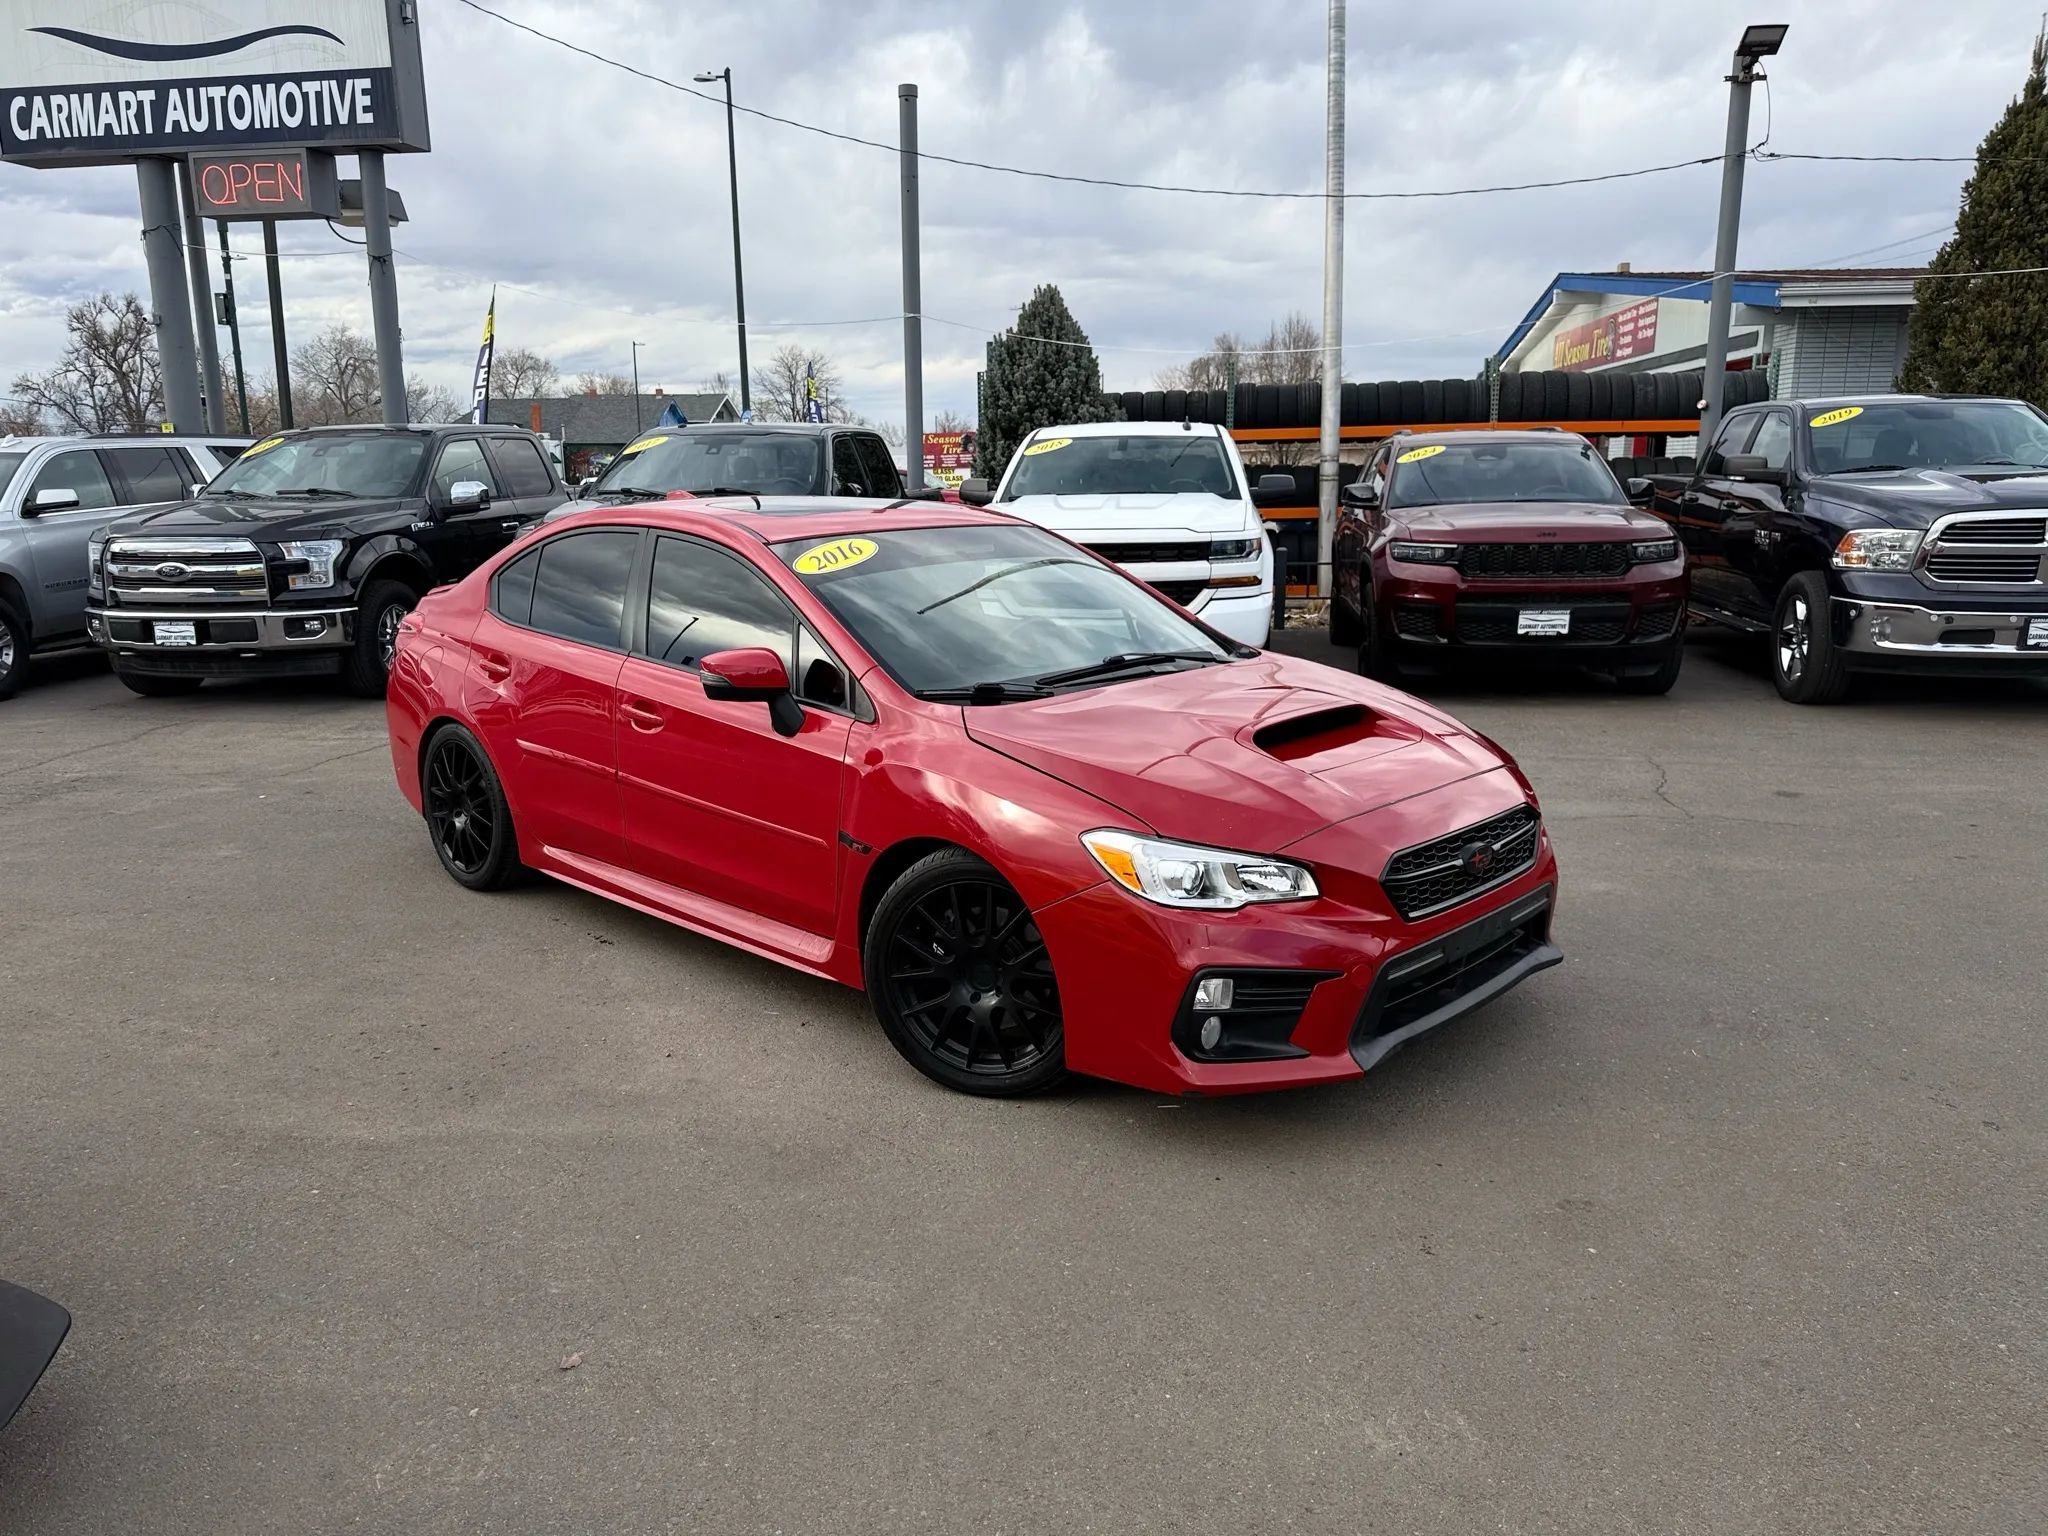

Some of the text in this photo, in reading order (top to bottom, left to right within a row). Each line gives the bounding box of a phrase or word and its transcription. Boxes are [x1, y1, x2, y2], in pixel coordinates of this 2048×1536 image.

[9, 78, 374, 141] CARMART AUTOMOTIVE
[202, 162, 303, 205] OPEN
[1563, 339, 1591, 366] Season
[1590, 328, 1609, 359] Tire
[1821, 409, 1853, 425] 2019
[927, 434, 962, 444] Season
[942, 444, 963, 454] Tire
[808, 541, 864, 571] 2016
